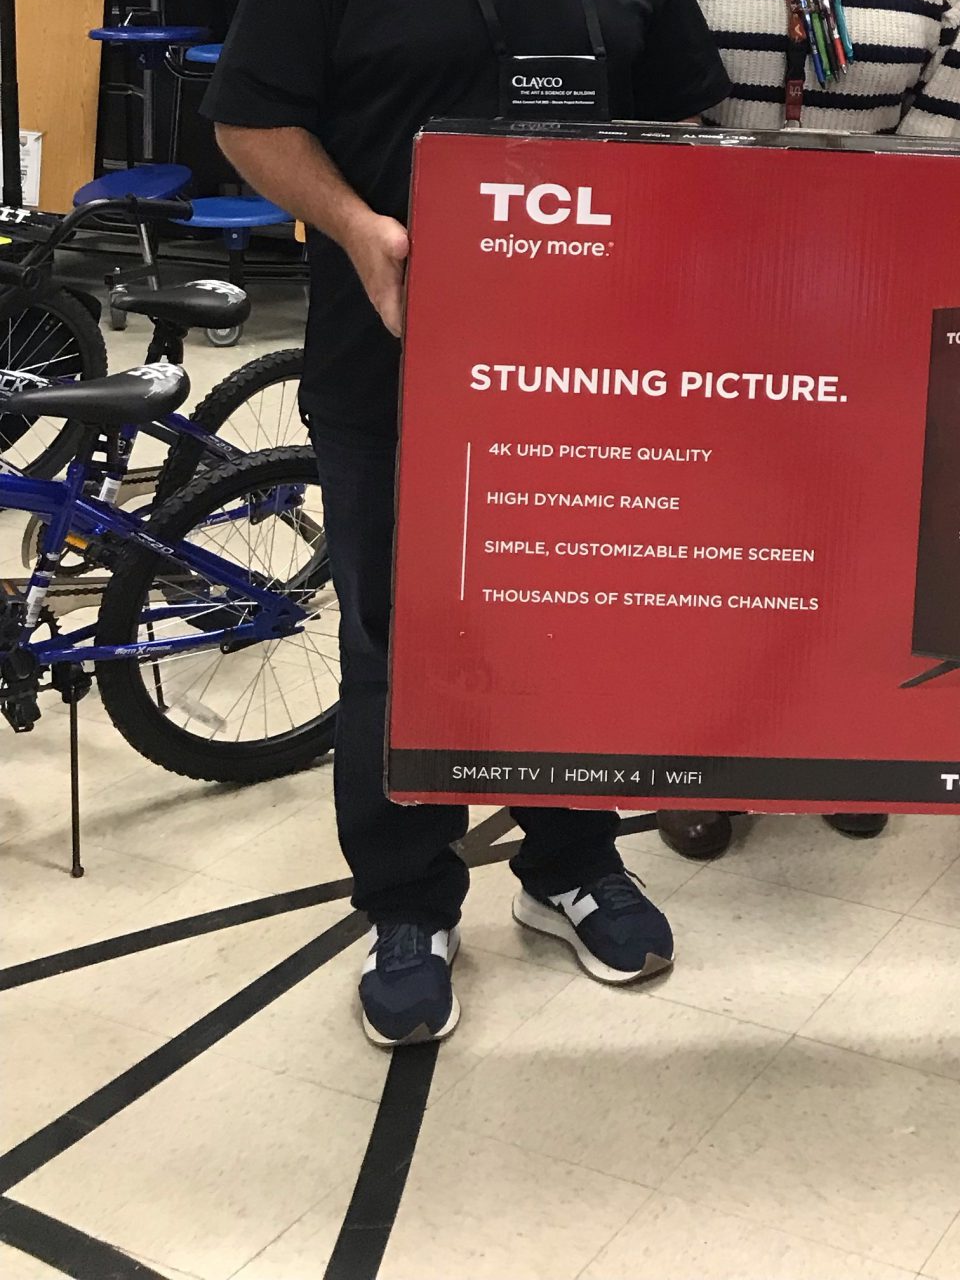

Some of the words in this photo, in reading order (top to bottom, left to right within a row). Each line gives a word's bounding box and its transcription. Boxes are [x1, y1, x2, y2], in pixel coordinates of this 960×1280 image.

[512, 75, 563, 89] CLAYCO
[480, 182, 611, 226] TCL
[480, 234, 542, 259] enjoy
[0, 374, 30, 392] CK
[470, 363, 667, 398] STUNNING
[680, 370, 848, 403] PICTURE.
[488, 443, 513, 458] 4K
[516, 444, 554, 459] UHD
[559, 445, 632, 461] PICTURE
[637, 447, 713, 463] QUALITY
[487, 491, 529, 507] HIGH
[534, 493, 615, 509] DYNAMIC
[620, 496, 680, 511] RANGE
[484, 540, 550, 557] SIMPLE,
[555, 542, 688, 559] CUSTOMIZABLE
[693, 546, 744, 561] HOME
[748, 547, 816, 563] SCREEN
[482, 589, 590, 605] THOUSANDS
[594, 591, 619, 606] OF
[623, 592, 723, 609] STREAMING
[727, 595, 819, 611] CHANNELS
[452, 767, 512, 780] SMART
[518, 768, 540, 781] TV
[565, 769, 608, 782] HDMI
[614, 770, 624, 783] X
[630, 770, 641, 783] 4
[666, 771, 702, 785] WiFi
